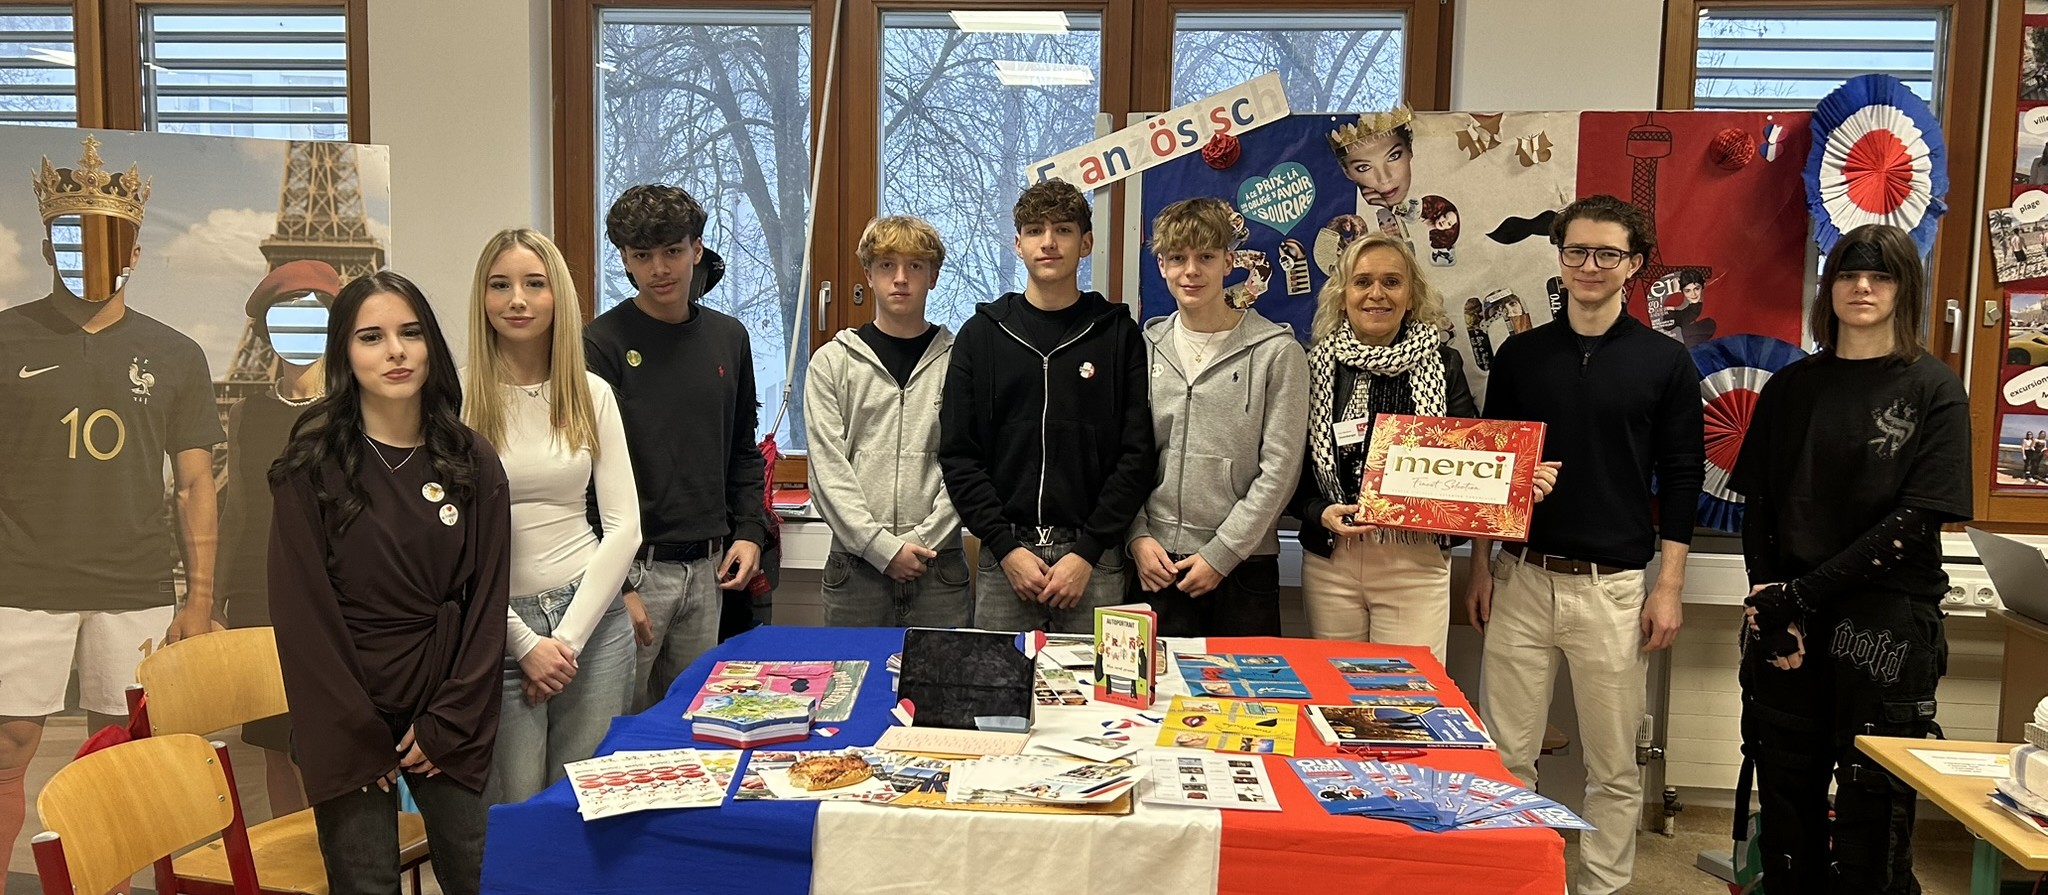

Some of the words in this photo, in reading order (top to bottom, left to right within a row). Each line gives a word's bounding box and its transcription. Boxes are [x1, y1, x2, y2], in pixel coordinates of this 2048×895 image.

[1036, 82, 1281, 185] Französisch
[1249, 190, 1258, 199] CE
[1257, 189, 1314, 223] SOURIRE
[2019, 200, 2041, 214] plage
[60, 407, 126, 461] 10
[1395, 456, 1506, 479] merci
